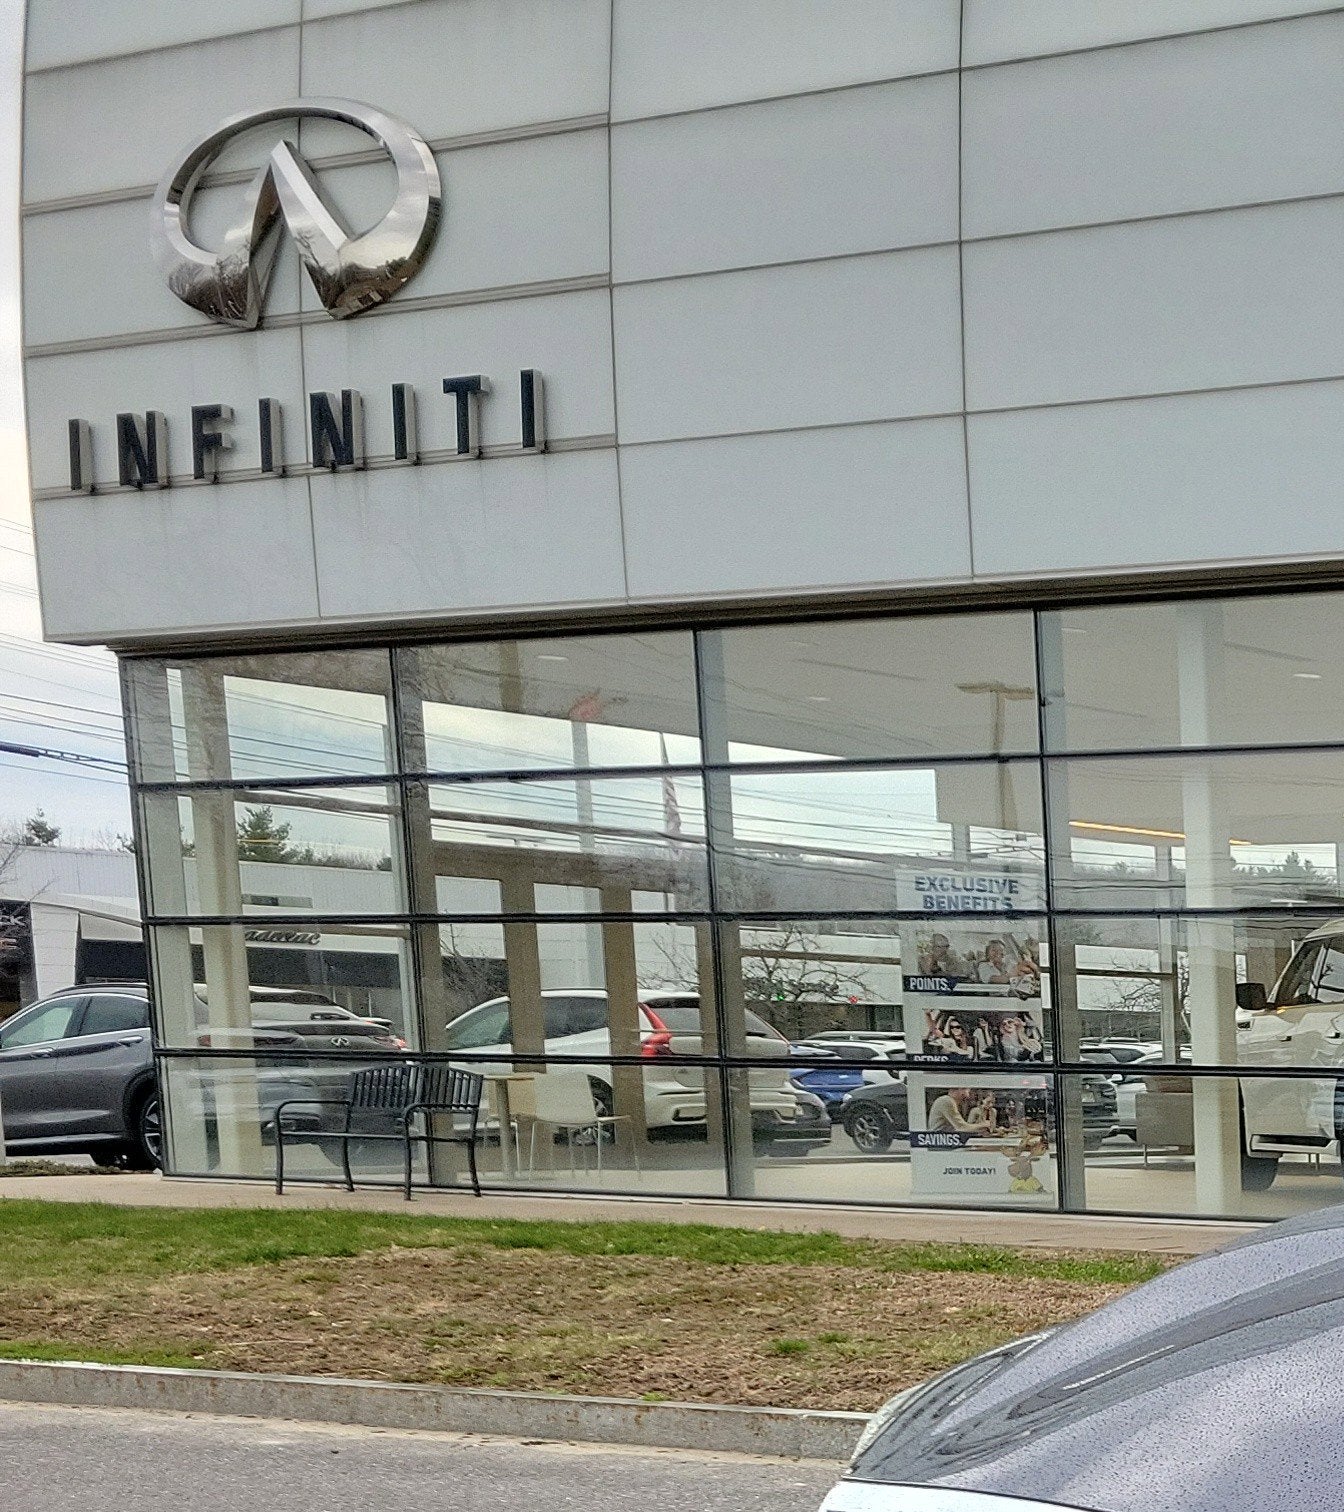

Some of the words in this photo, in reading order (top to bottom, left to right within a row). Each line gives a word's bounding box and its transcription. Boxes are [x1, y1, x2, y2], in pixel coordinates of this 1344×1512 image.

[67, 368, 549, 492] INFINITI
[914, 876, 1019, 894] EXCLUSIVE
[923, 894, 1013, 910] BENEFITS
[943, 1167, 963, 1175] JOIN
[965, 1167, 996, 1175] TODAY!
